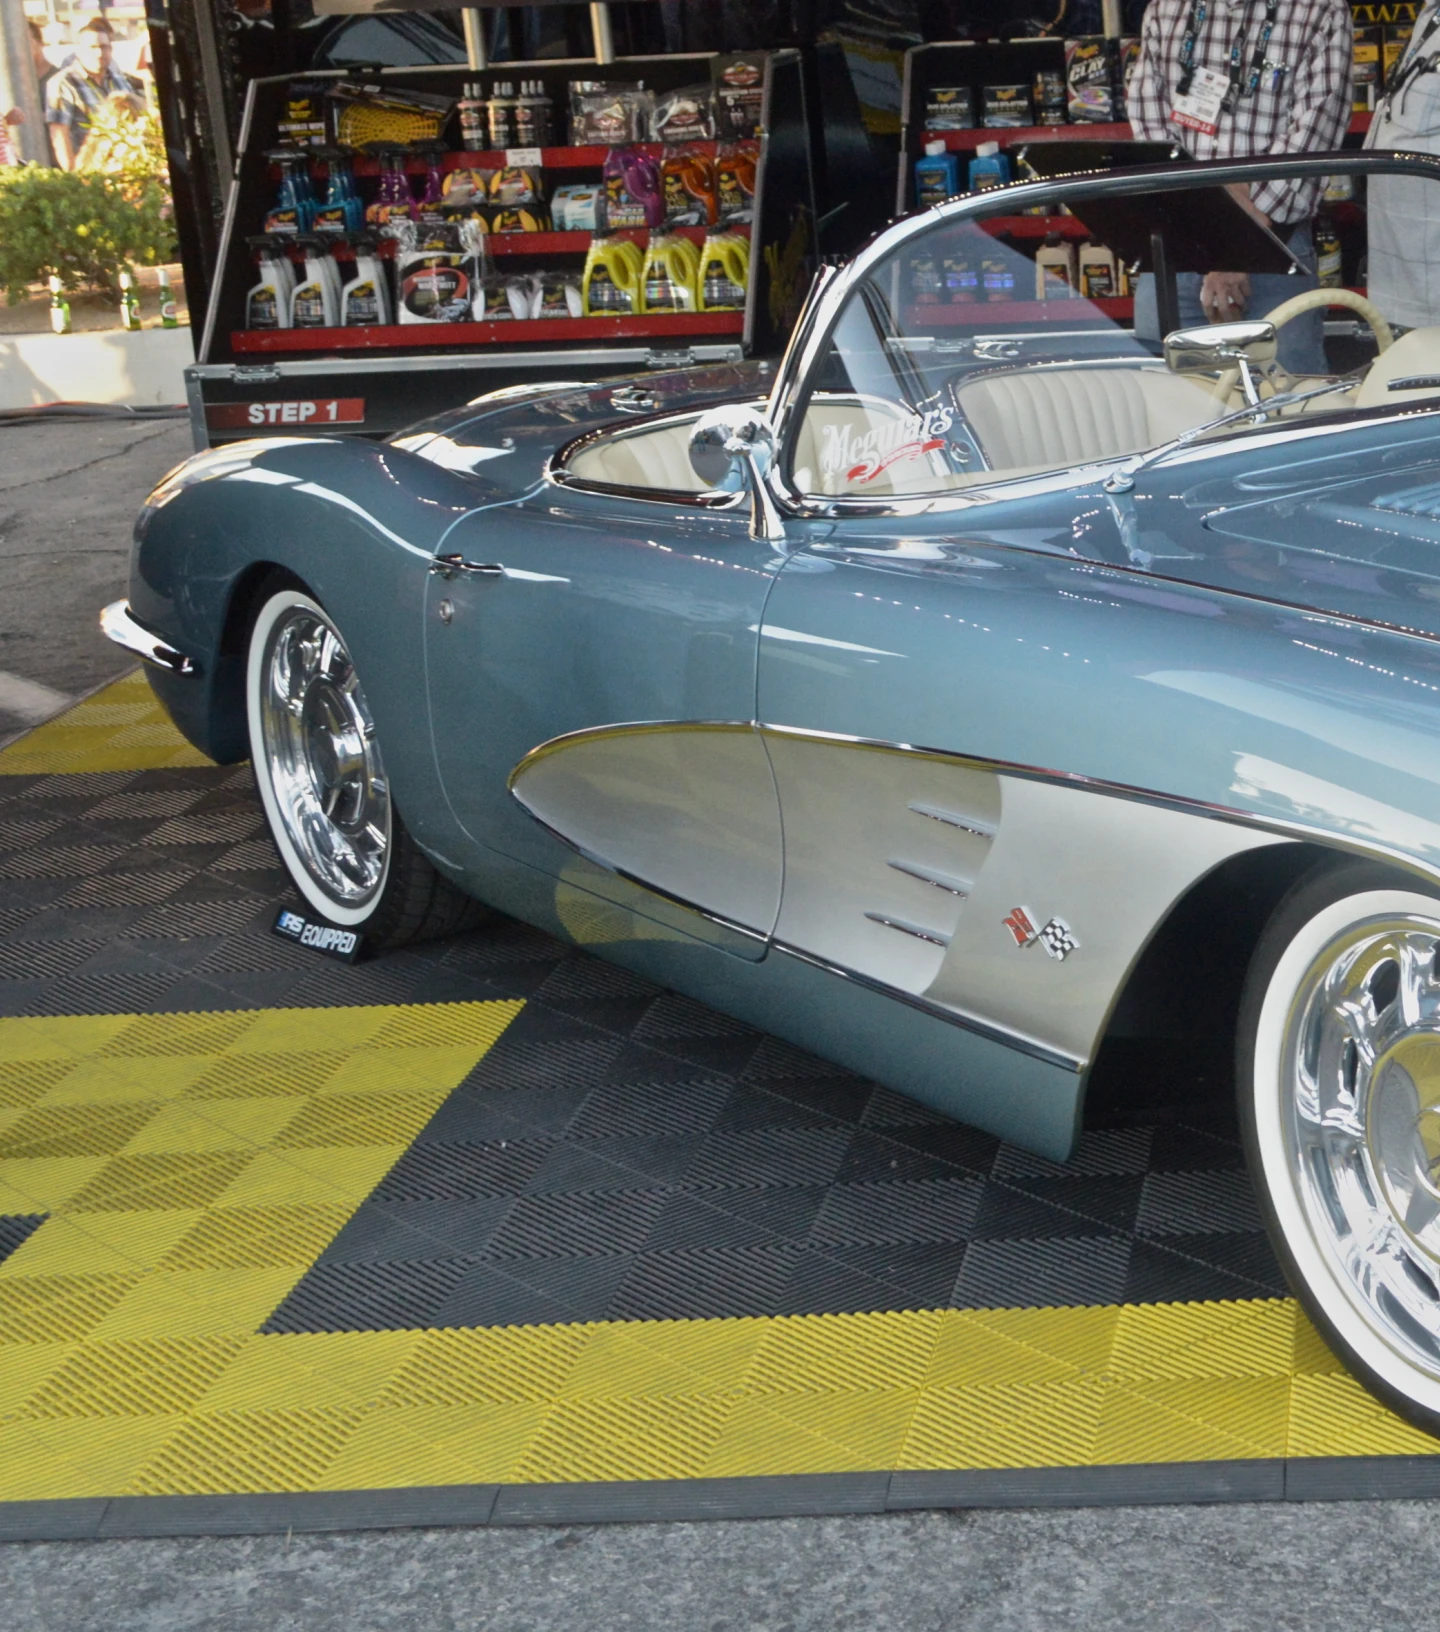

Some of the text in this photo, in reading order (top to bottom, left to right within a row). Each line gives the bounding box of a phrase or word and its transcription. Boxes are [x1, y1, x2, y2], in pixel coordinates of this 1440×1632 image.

[1069, 57, 1104, 82] CLAY
[248, 401, 338, 424] STEP 1
[820, 403, 954, 484] Meguiar's
[300, 923, 357, 954] EQUIPPED
